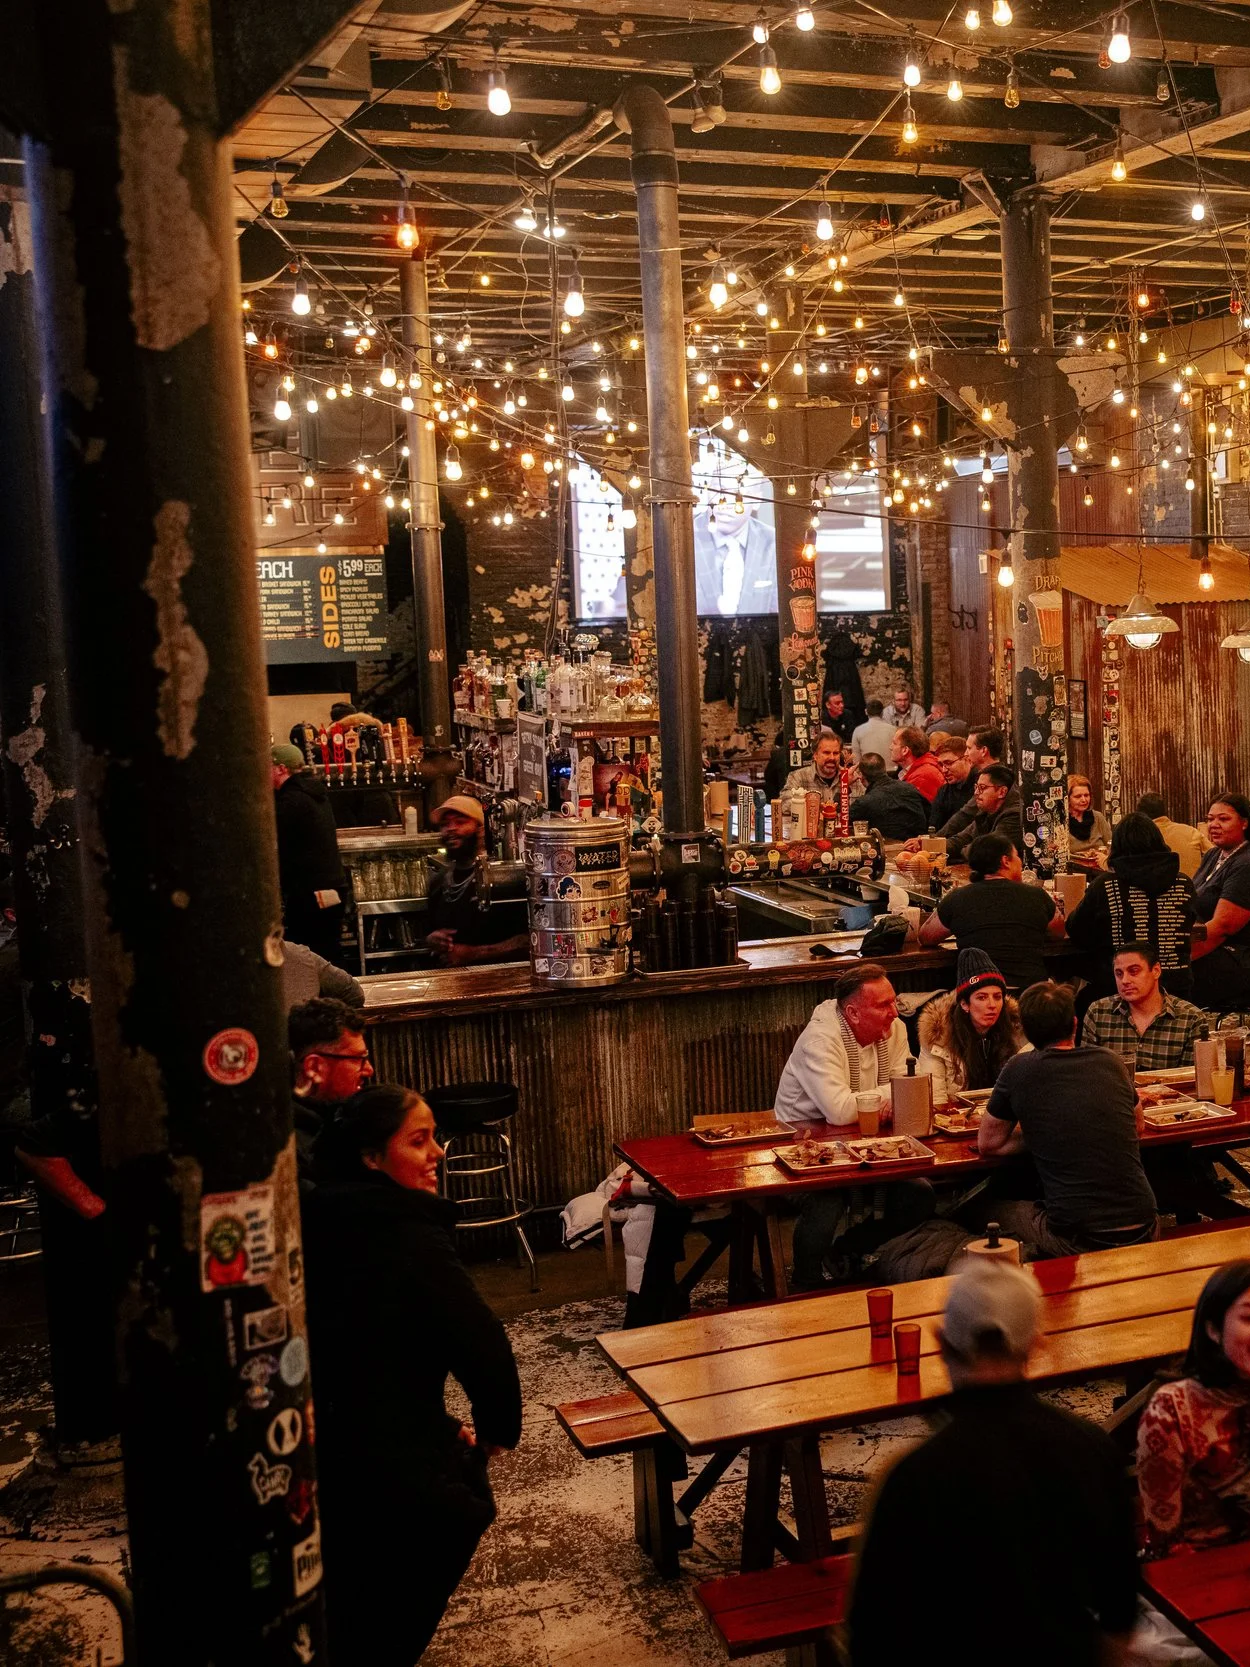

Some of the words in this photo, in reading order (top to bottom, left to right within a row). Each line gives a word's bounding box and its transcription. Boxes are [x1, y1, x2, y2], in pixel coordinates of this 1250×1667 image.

[337, 559, 364, 578] $5.99
[364, 563, 383, 573] EACH
[790, 566, 815, 580] PINK
[319, 566, 340, 649] SIDES
[579, 850, 618, 866] WATER
